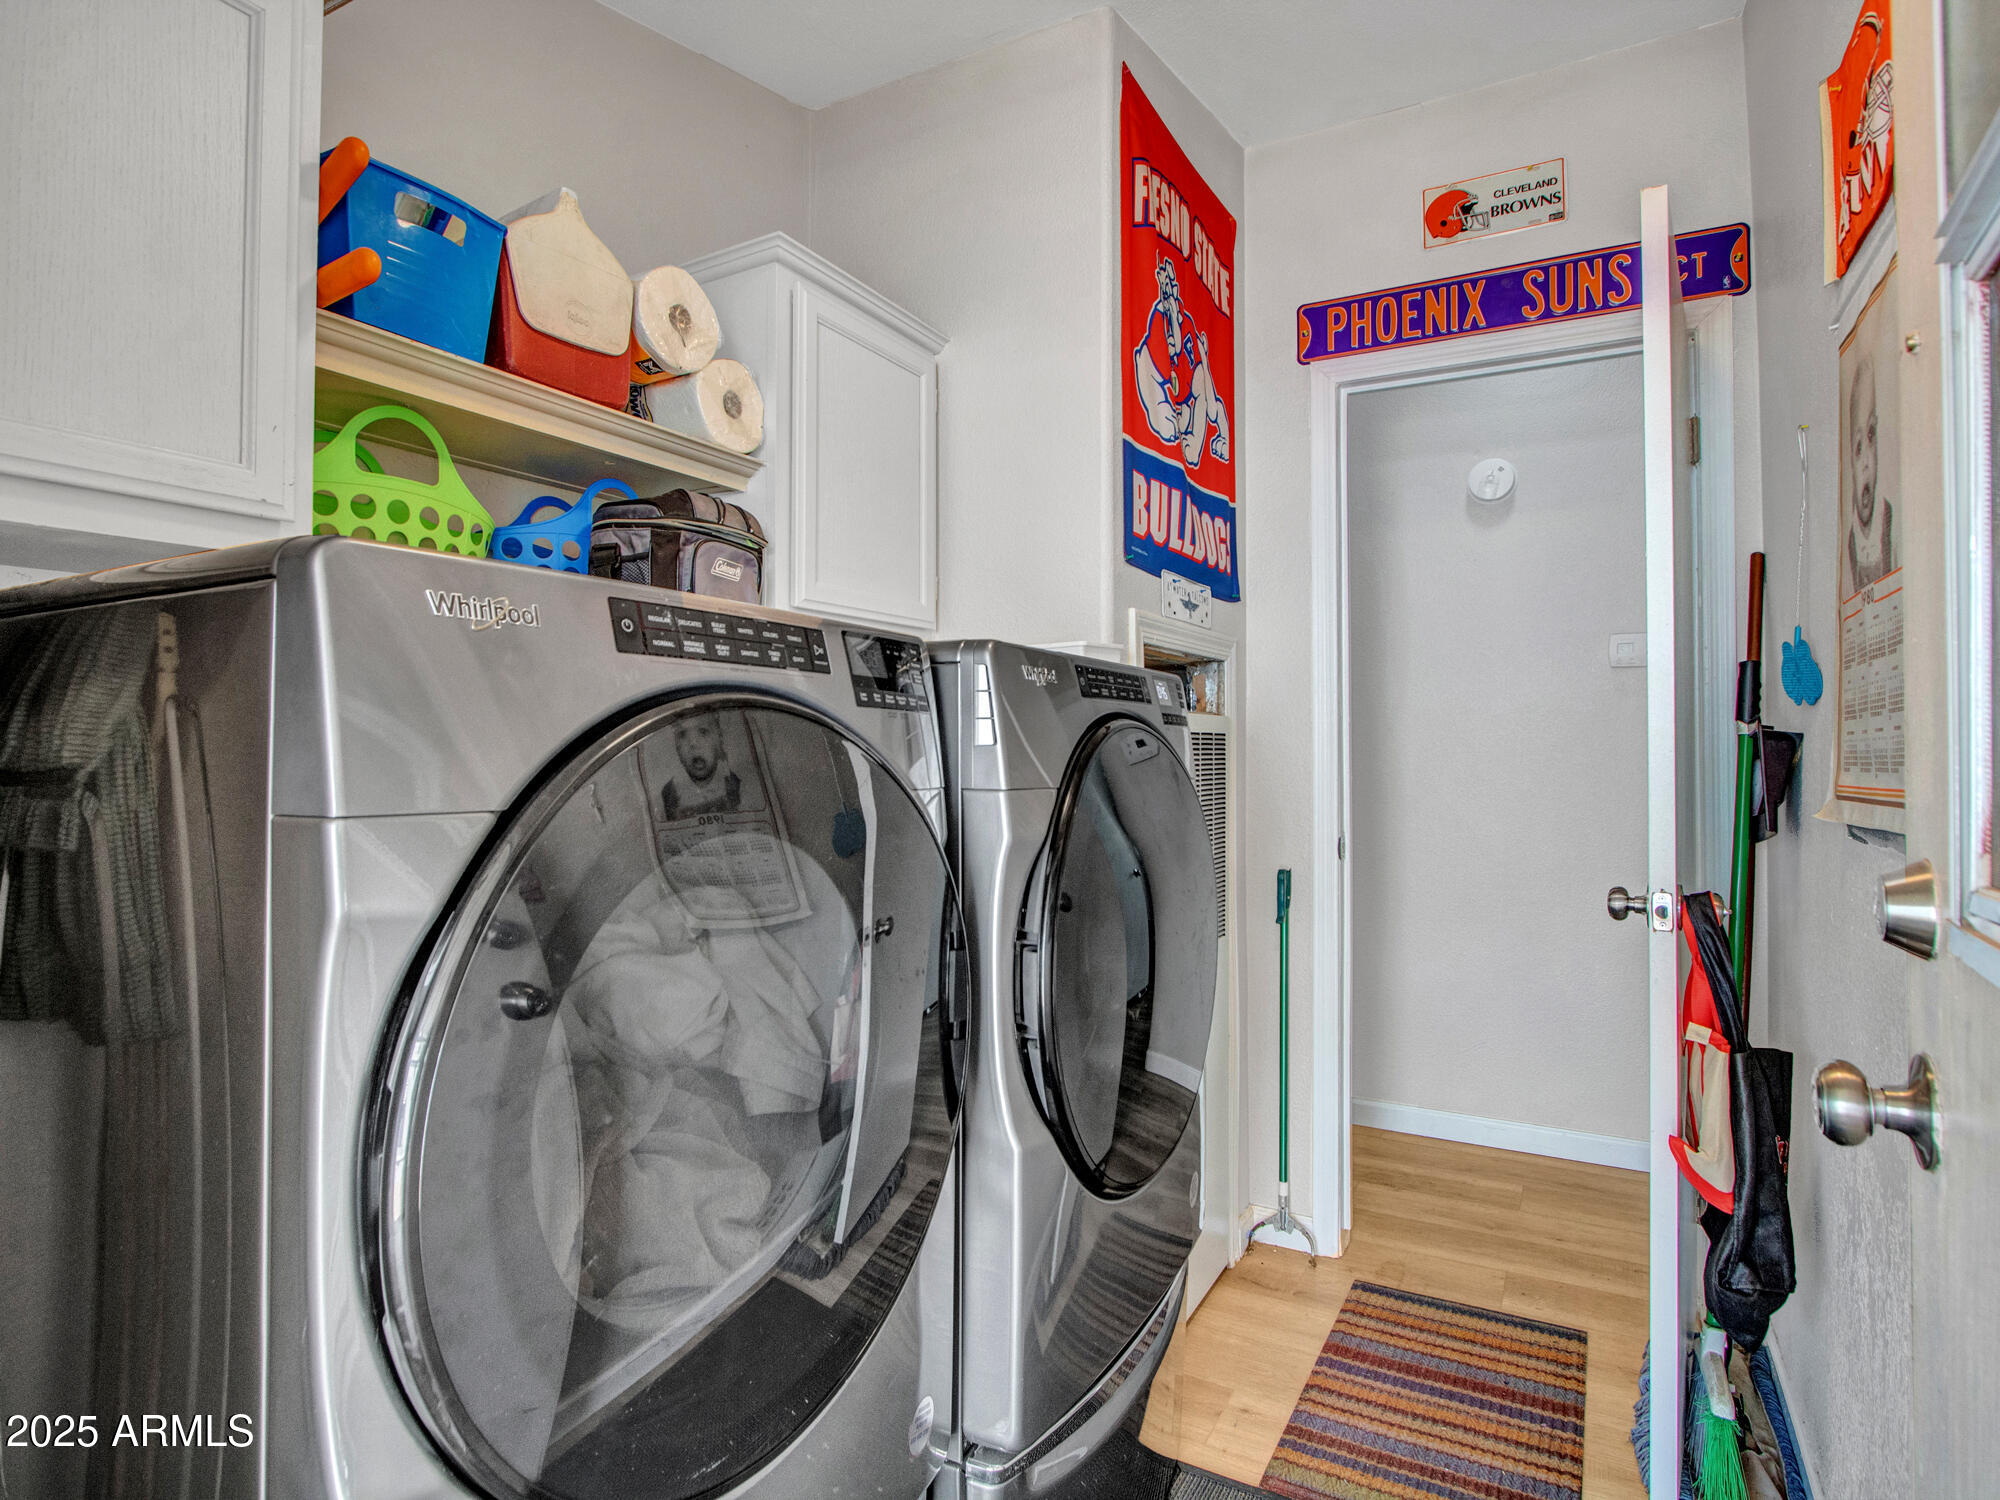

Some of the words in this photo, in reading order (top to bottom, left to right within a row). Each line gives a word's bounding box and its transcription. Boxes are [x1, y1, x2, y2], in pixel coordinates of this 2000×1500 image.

[1490, 190, 1562, 218] BROWNS
[1493, 176, 1559, 199] CLEVELAND
[1193, 219, 1231, 318] STATE
[1326, 278, 1487, 352] PHOENIX
[1520, 253, 1633, 320] SUNS
[1676, 250, 1708, 282] CT
[425, 589, 541, 629] Whirlpool
[652, 639, 676, 648] NORMAL
